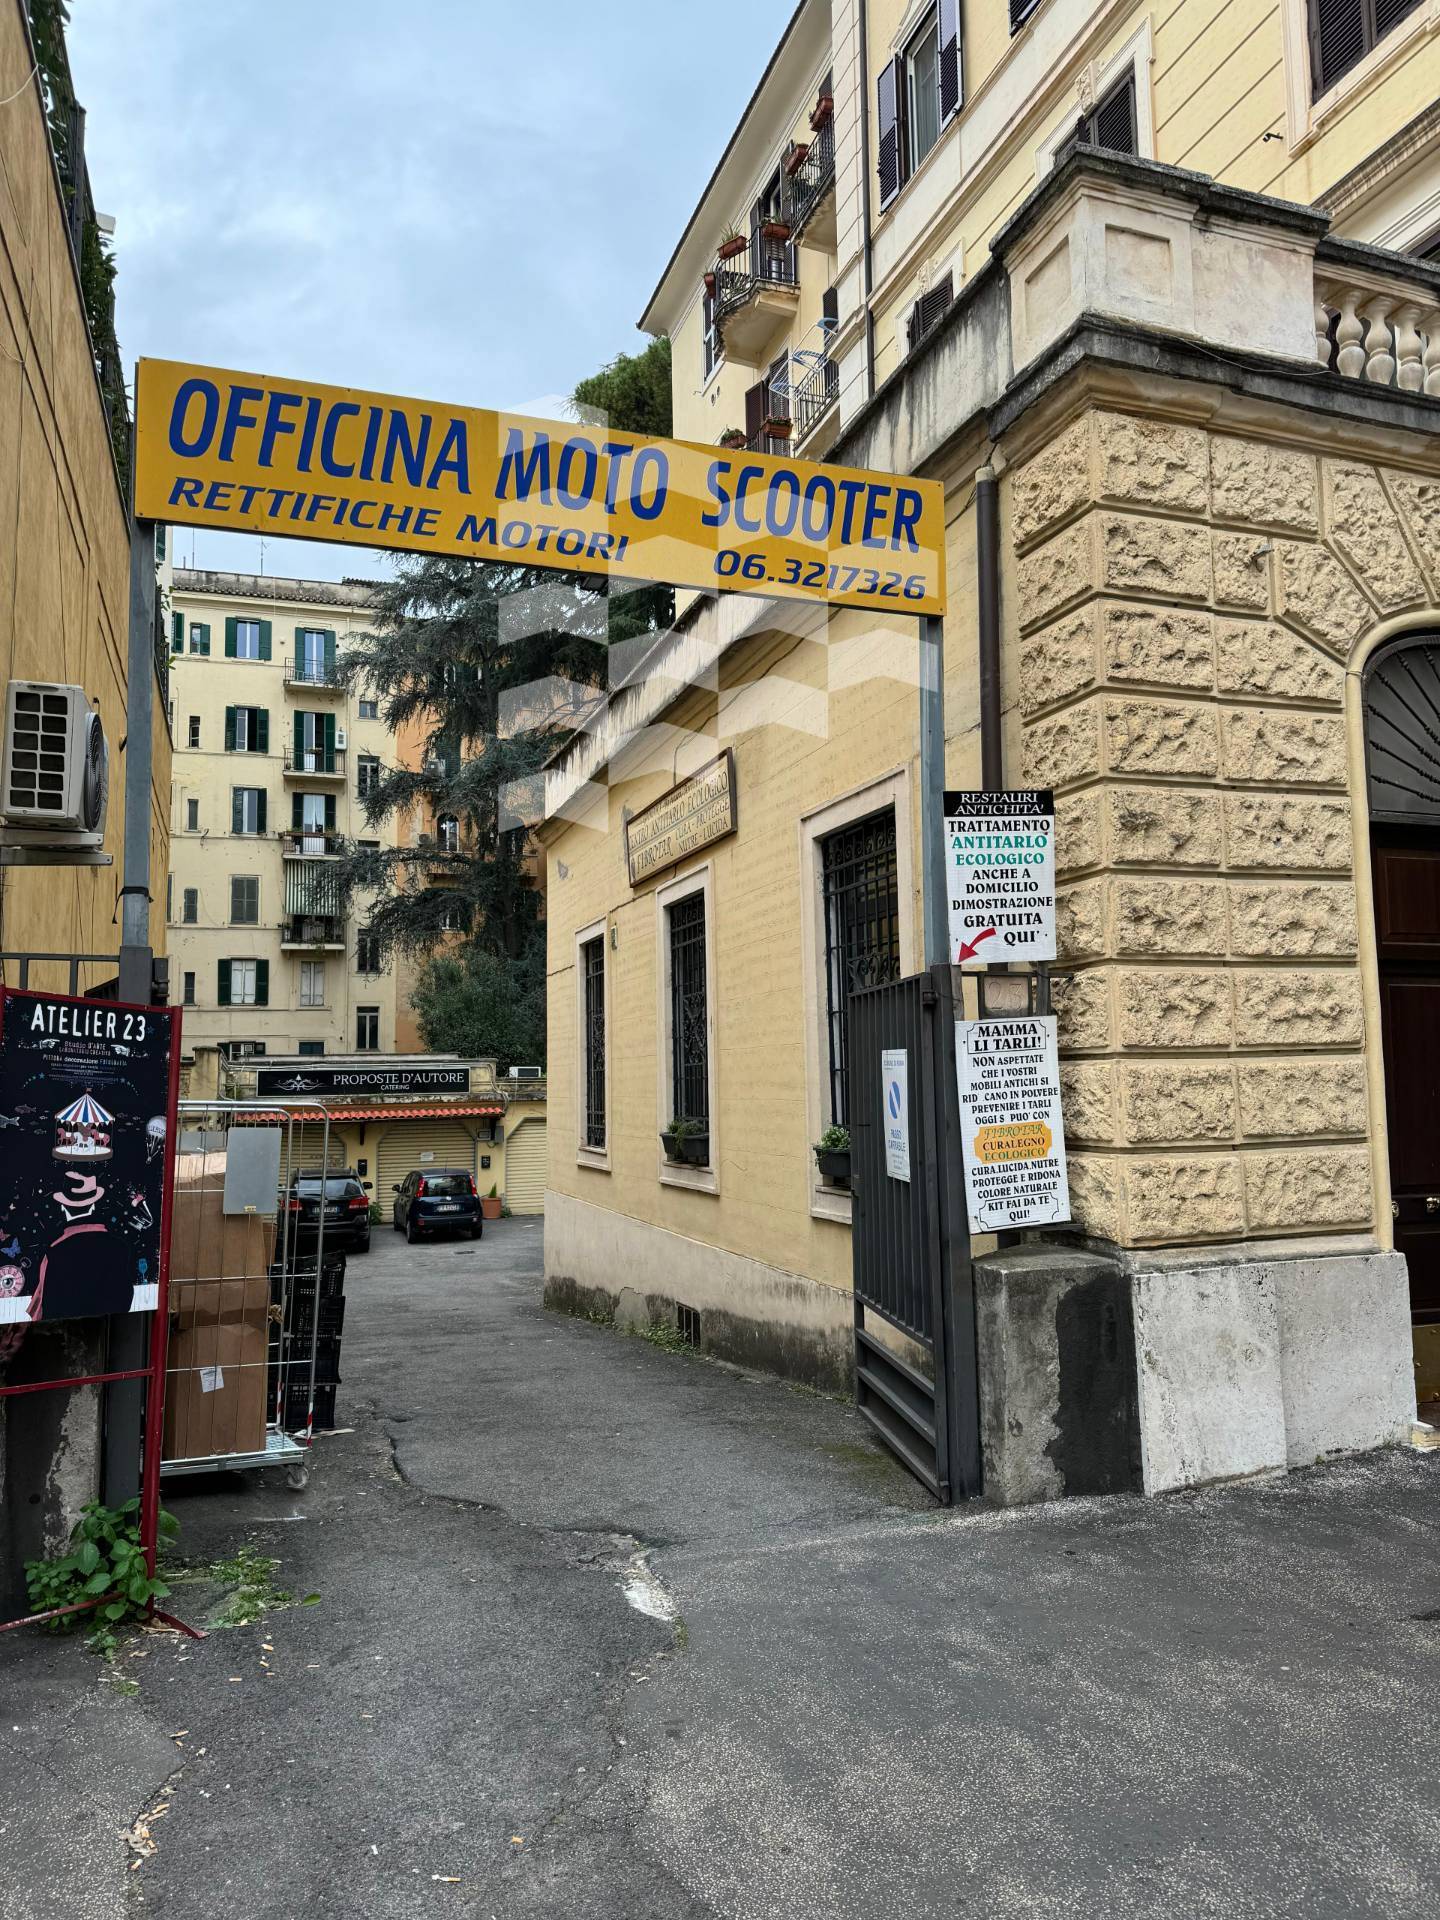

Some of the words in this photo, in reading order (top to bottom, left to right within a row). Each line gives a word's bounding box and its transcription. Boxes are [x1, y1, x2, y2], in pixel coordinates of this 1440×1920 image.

[168, 378, 472, 494] OFFICINA
[494, 427, 669, 520] MOTO
[701, 461, 923, 554] SCOOTER
[168, 476, 443, 537] RETTIFICHE
[455, 514, 629, 562] MOTORI
[713, 549, 926, 600] 06.3217326
[961, 792, 1038, 803] RESTAURI
[954, 804, 1044, 815] ANTICHITA'
[948, 819, 1050, 833] TRATTAMENTO
[952, 835, 1048, 849] ANTITARLO
[955, 852, 1045, 866] ECOLOGICO
[972, 868, 1018, 880] ANCHE
[1021, 868, 1031, 879] A
[966, 881, 1039, 894] DOMICILIO
[952, 896, 1053, 910] DIMOSTRAZIONE
[964, 912, 1043, 927] GRATUITA
[30, 1003, 116, 1039] ATELIER
[123, 1013, 146, 1042] 23
[977, 1023, 1038, 1038] MAMMA
[974, 1039, 988, 1051] LI
[993, 1036, 1041, 1050] TARLI!
[972, 1056, 995, 1067] NON
[997, 1054, 1044, 1065] ASPETTATE
[333, 1073, 399, 1085] PROPOSTE
[402, 1072, 464, 1083] D'AUTORE
[981, 1069, 998, 1078] CHE
[1001, 1068, 1004, 1077] I
[1006, 1066, 1037, 1076] VOSTRI
[970, 1080, 1001, 1091] MOBILI
[1003, 1077, 1038, 1088] ANTICHI
[1040, 1076, 1049, 1085] SI
[1010, 1090, 1019, 1099] IN
[1021, 1087, 1058, 1098] POLVERE
[971, 1101, 1022, 1114] PREVENIRE
[1027, 1099, 1051, 1109] TARLI
[975, 1115, 997, 1125] OGGI
[1010, 1112, 1031, 1122] PUO'
[1032, 1110, 1050, 1120] CON
[982, 1137, 1045, 1151] CURALEGNO
[985, 1147, 1045, 1161] ECOLOGICO
[972, 1174, 1018, 1188] PROTEGGE
[1020, 1173, 1025, 1182] E
[1028, 1169, 1061, 1181] RIDONA
[977, 1187, 1011, 1199] COLORE
[1013, 1181, 1058, 1195] NATURALE
[988, 1201, 1003, 1211] KIT
[1006, 1199, 1020, 1209] FAI
[1023, 1197, 1036, 1207] DA
[1038, 1195, 1049, 1205] TE
[1009, 1209, 1030, 1221] QUI!
